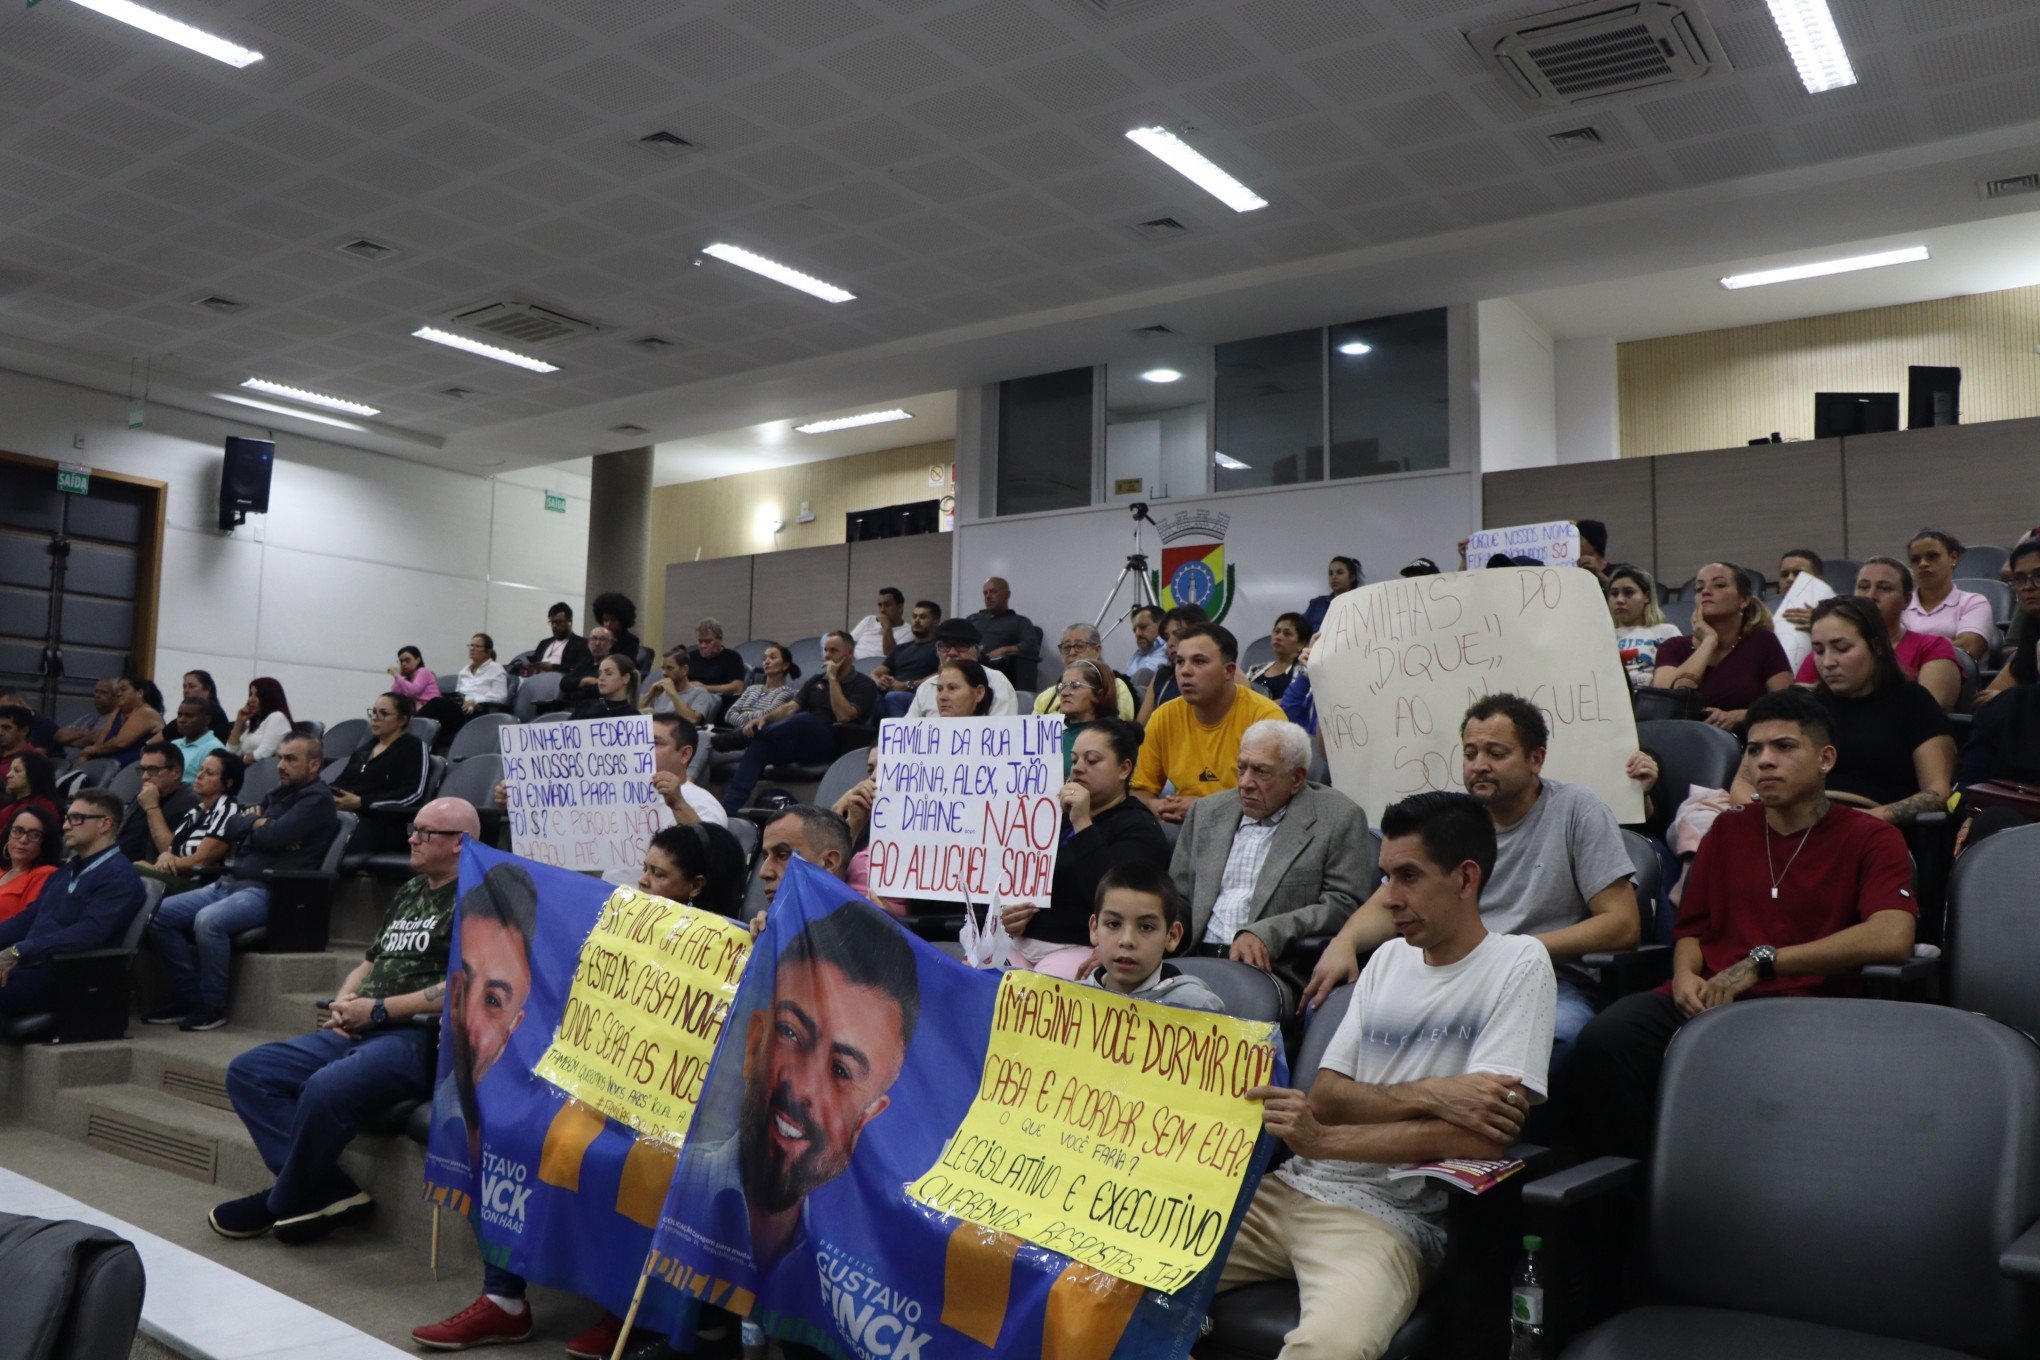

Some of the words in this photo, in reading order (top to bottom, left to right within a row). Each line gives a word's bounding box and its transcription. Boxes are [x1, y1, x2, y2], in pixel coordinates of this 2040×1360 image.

[59, 472, 87, 490] SAÍDA
[1504, 527, 1537, 546] NOSSOS
[1517, 570, 1562, 616] DO
[501, 727, 512, 754] O
[520, 723, 581, 752] DINHEIRO
[591, 720, 655, 749] FEDERAL
[882, 721, 941, 755] FAMÍLIA
[951, 728, 971, 756] DA
[981, 727, 1011, 757] RUA
[1023, 715, 1064, 756] LIMA
[1323, 704, 1368, 753] NÃO
[1395, 696, 1433, 737] AO
[503, 755, 527, 781] DAS
[532, 752, 584, 780] NOSSAS
[588, 752, 627, 777] CASAS
[634, 746, 654, 775] JÁ
[879, 761, 948, 796] MARINA,
[952, 764, 998, 799] ALEX,
[1006, 758, 1048, 795] JOÃO
[505, 780, 523, 808] FOI
[581, 781, 617, 806] PARA
[623, 782, 657, 805] ONDE
[552, 810, 565, 836] E
[570, 809, 620, 836] PORQUE
[625, 804, 660, 835] NÃO
[873, 797, 890, 829] E
[982, 794, 1057, 851] NÃO
[575, 837, 600, 865] ATÉ
[868, 840, 899, 888] AO
[903, 844, 990, 895] ALUGUEL
[998, 847, 1052, 898] SOCIAL
[381, 931, 430, 952] CRISTO
[680, 926, 729, 970] ATÉ
[588, 945, 622, 994] ESTÁ
[614, 955, 636, 1000] DE
[631, 965, 680, 1019] CASA
[671, 984, 730, 1045] NOVA
[560, 997, 600, 1051] ONDE
[596, 1011, 635, 1069] SERÁ
[626, 1039, 660, 1084] AS
[996, 971, 1083, 1049] IMAGINA
[1092, 1004, 1140, 1065] VOCÊ
[1141, 1019, 1229, 1096] DORMIR
[677, 1110, 687, 1123] A
[981, 1053, 1031, 1110] CASA
[1036, 1070, 1056, 1112] E
[1053, 1076, 1145, 1148] ACORDAR
[1142, 1106, 1197, 1162] SEM
[1197, 1121, 1255, 1178] ELA?
[999, 1110, 1010, 1126] O
[1021, 1119, 1046, 1138] QUE
[1060, 1136, 1090, 1154] VOCÊ
[942, 1129, 1061, 1200] LEGISLATIVO
[1062, 1174, 1085, 1212] E
[1089, 1180, 1222, 1257] EXECUTIVO
[499, 1211, 524, 1234] HAAS
[919, 1175, 1032, 1231] QUEREMOS
[1032, 1220, 1142, 1275] RESPOSTAS
[819, 1239, 875, 1274] PREFEITO
[816, 1251, 922, 1323] GUSTAVO
[818, 1269, 933, 1360] FINCK
